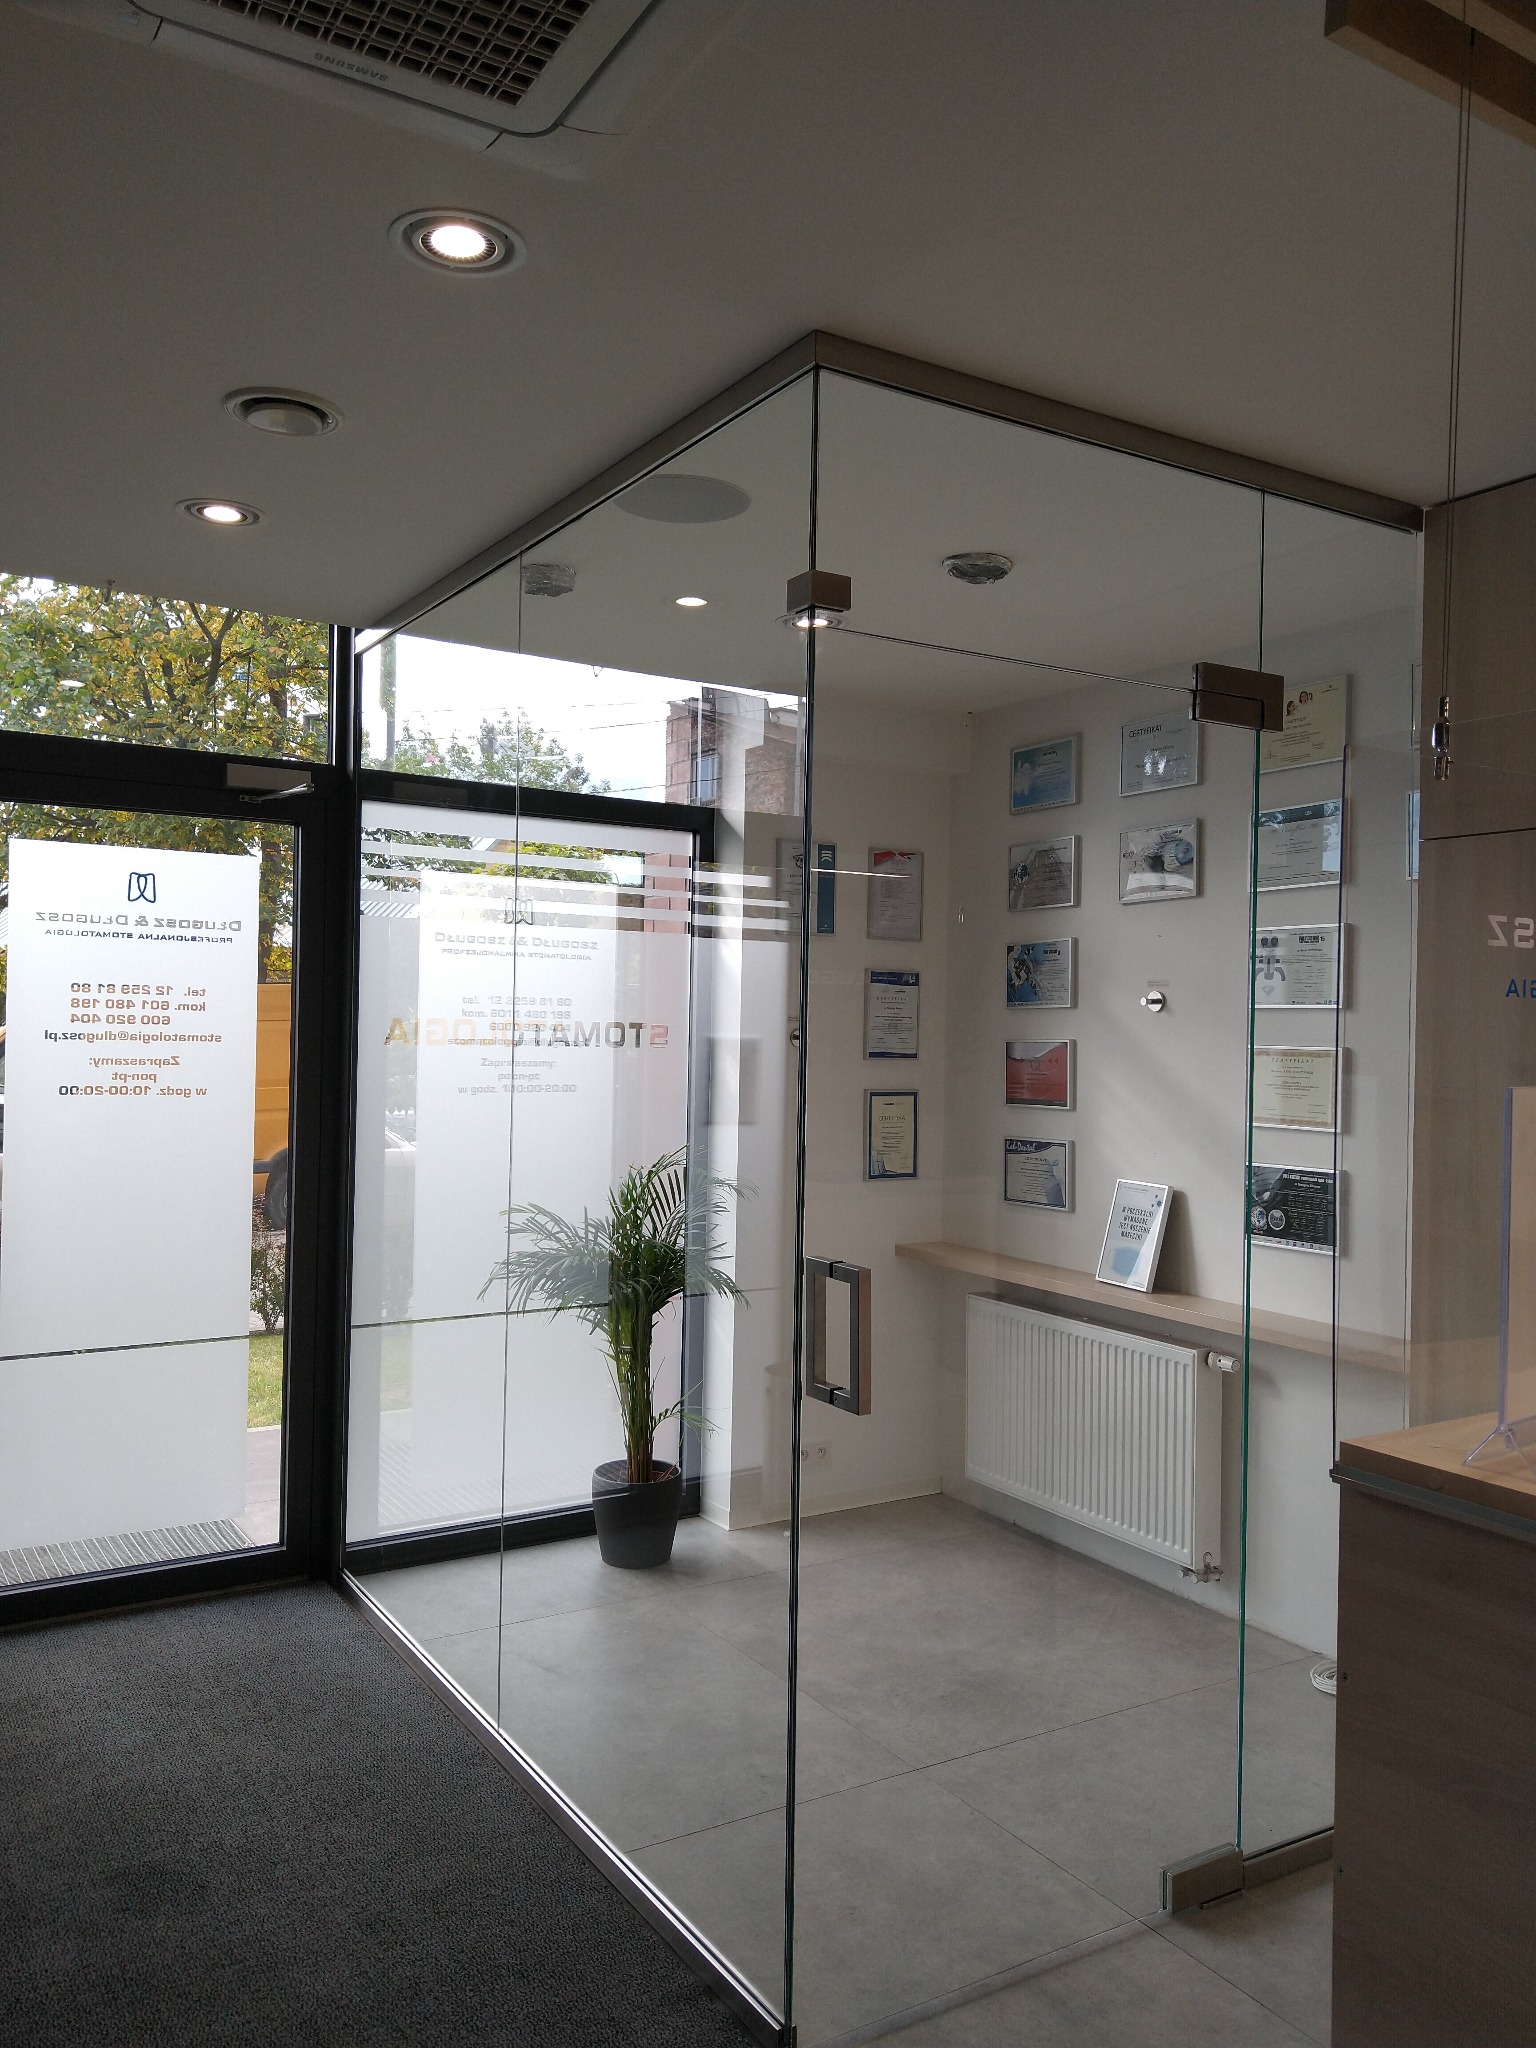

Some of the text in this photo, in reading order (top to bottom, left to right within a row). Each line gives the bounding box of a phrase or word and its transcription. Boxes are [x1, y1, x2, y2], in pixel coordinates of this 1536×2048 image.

[314, 53, 388, 81] SAMSUNG
[1129, 724, 1162, 737] CERTYFIKAT
[462, 1009, 488, 1017] kom.
